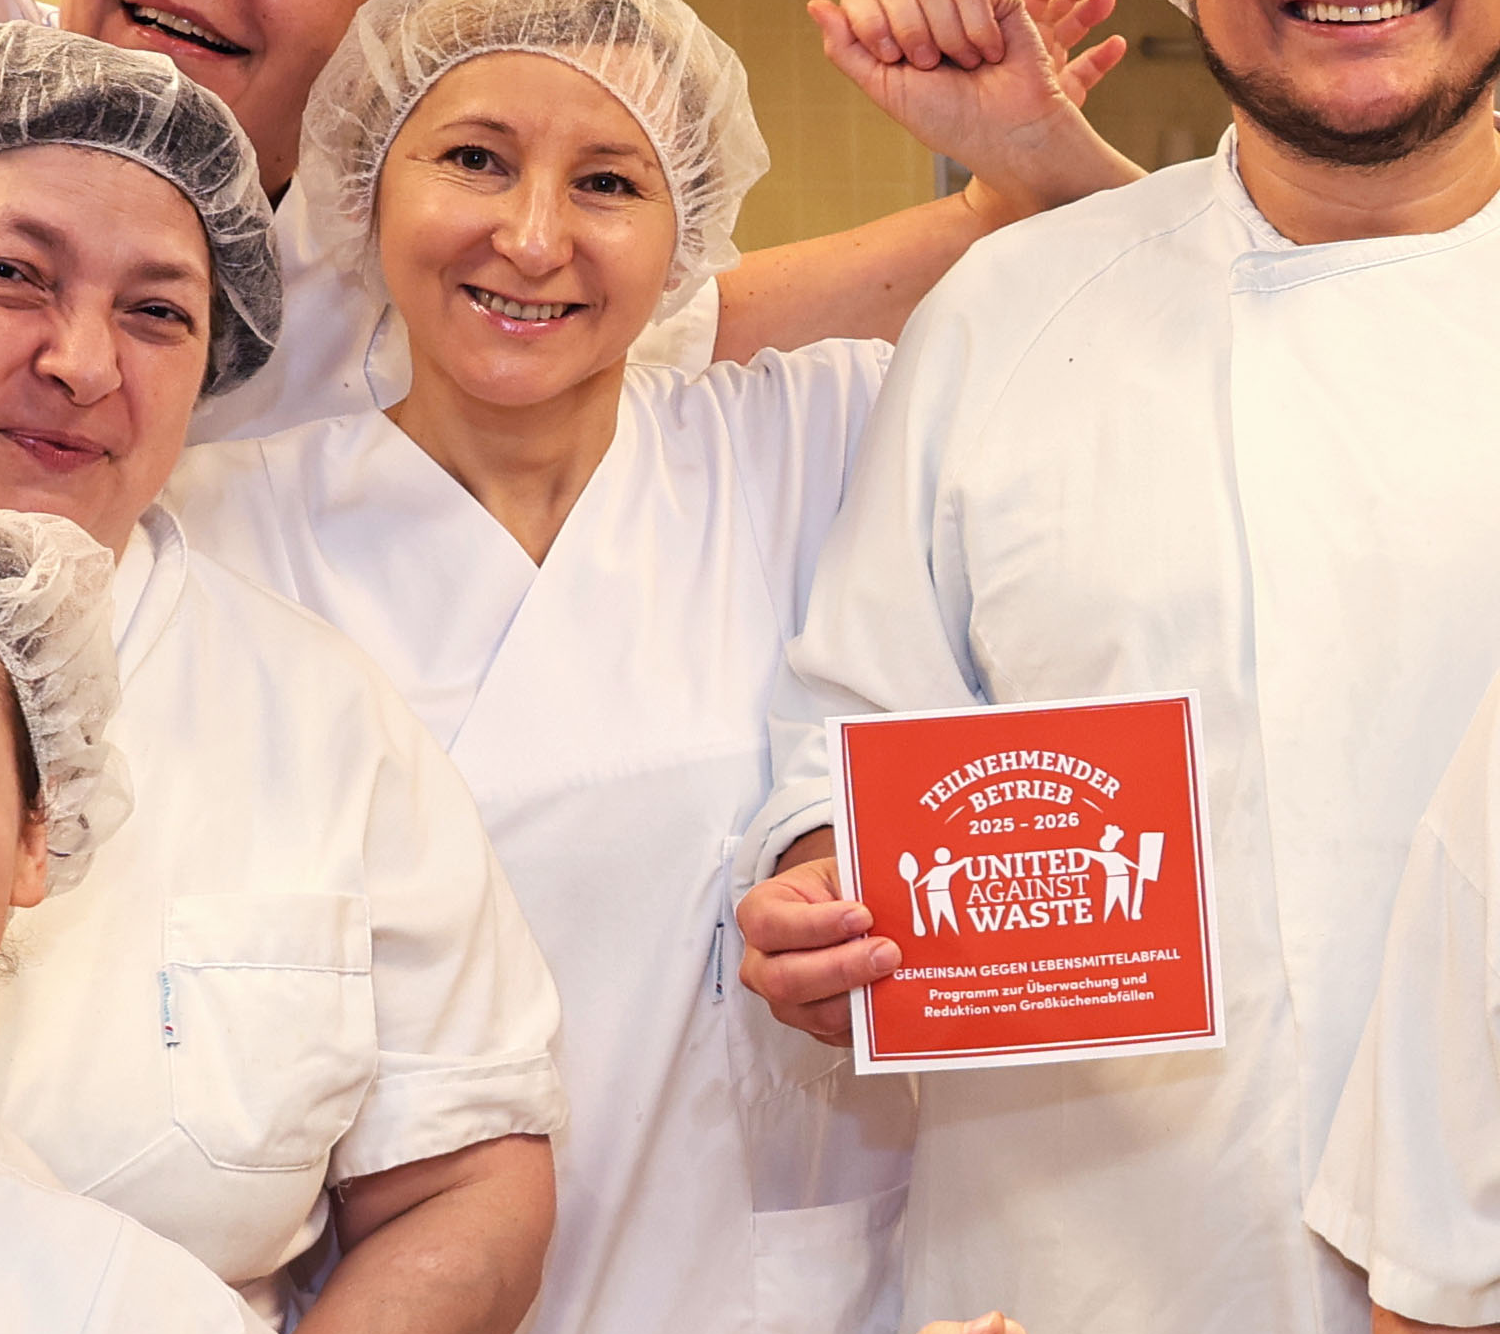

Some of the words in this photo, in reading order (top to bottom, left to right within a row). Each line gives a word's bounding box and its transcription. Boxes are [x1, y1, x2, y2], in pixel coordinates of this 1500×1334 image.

[920, 750, 1121, 812] TEILNEHMENDER
[968, 780, 1074, 813] BETRIEB
[969, 818, 1015, 835] 2025
[1034, 812, 1080, 830] 2026
[965, 848, 1091, 881] UNITED
[967, 874, 1090, 905] AGAINST
[966, 898, 1093, 932] WASTE
[894, 967, 977, 980] GEMEINSAM
[980, 962, 1028, 977] GEGEN
[1031, 948, 1181, 972] LEBENSMITTELABFALL
[929, 988, 999, 1002] Programm
[1002, 985, 1025, 996] zur
[1027, 977, 1119, 994] Überwachung
[1122, 972, 1148, 984] und
[924, 1005, 991, 1018] Reduktion
[994, 1003, 1017, 1013] von
[1019, 989, 1155, 1011] Großküchenabfällen
